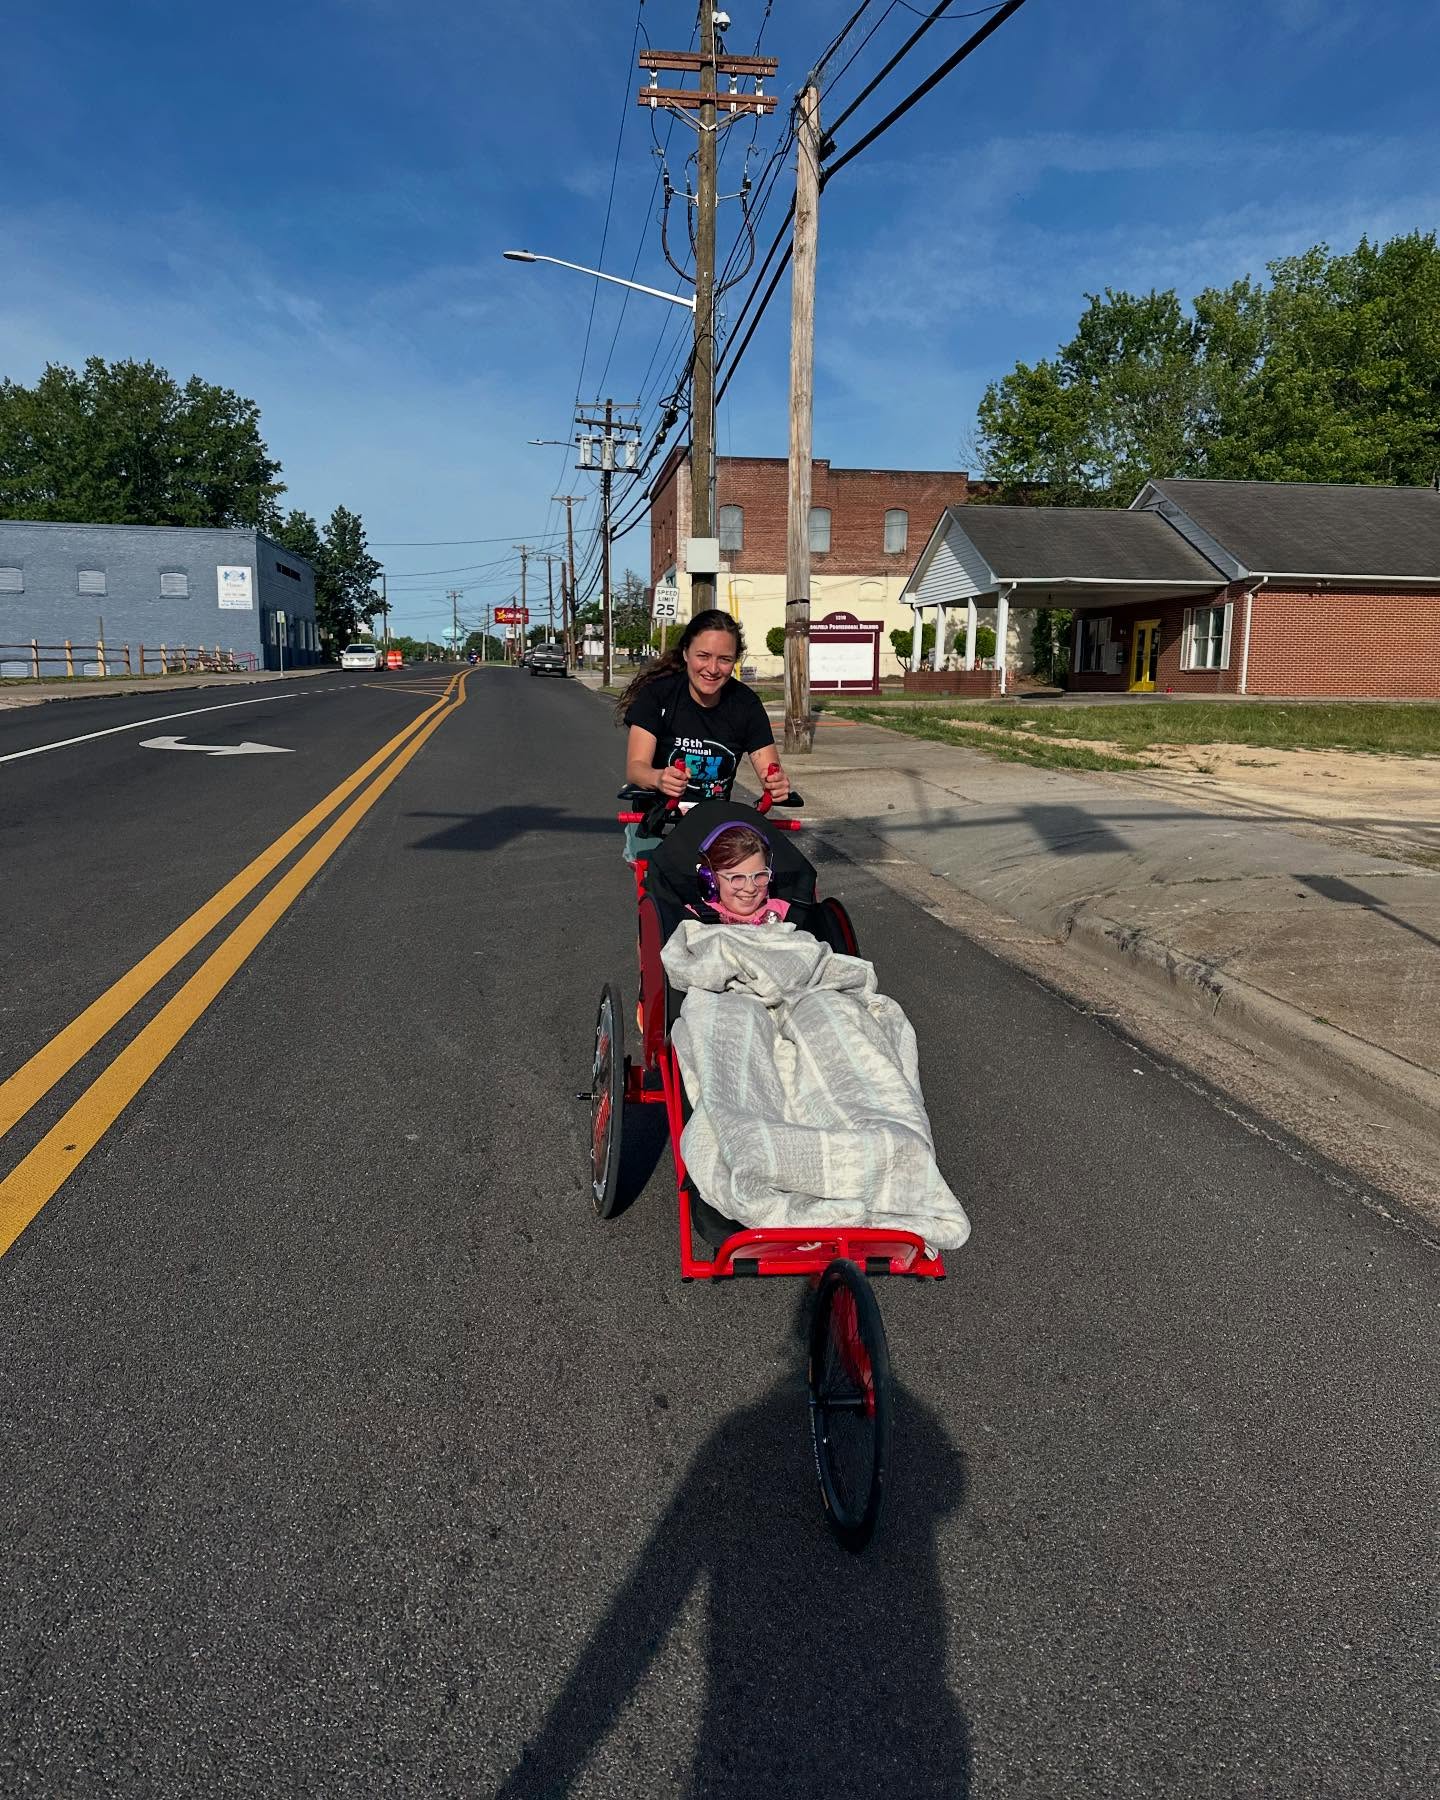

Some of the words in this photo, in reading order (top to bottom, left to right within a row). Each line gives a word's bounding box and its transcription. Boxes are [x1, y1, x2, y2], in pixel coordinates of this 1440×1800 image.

[656, 604, 675, 616] 25
[674, 737, 702, 748] 36th
[680, 747, 712, 755] Annual
